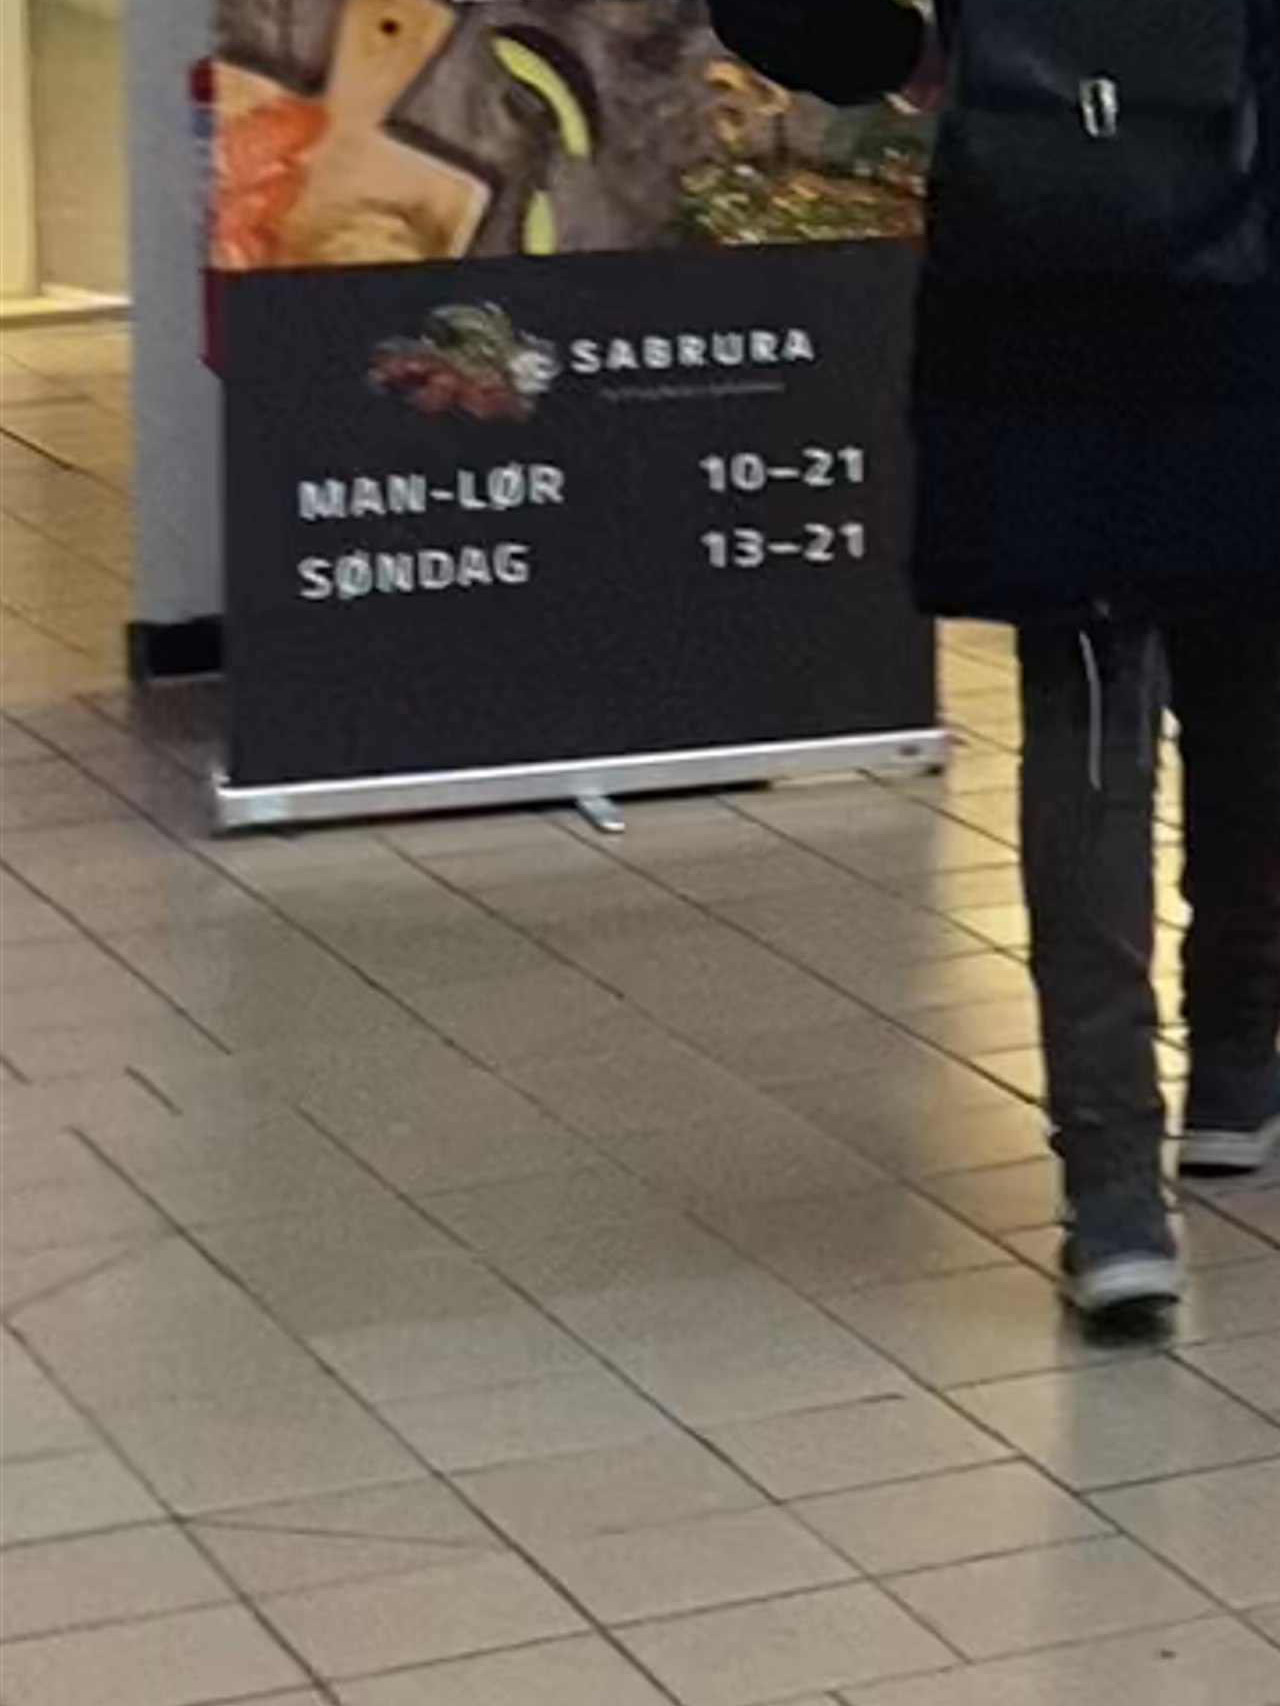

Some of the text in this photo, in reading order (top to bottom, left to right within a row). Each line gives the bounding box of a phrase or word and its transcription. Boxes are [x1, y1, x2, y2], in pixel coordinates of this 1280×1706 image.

[570, 327, 814, 374] SABRURA
[299, 461, 564, 520] MAN-LØR
[297, 541, 530, 600] SØNDAG
